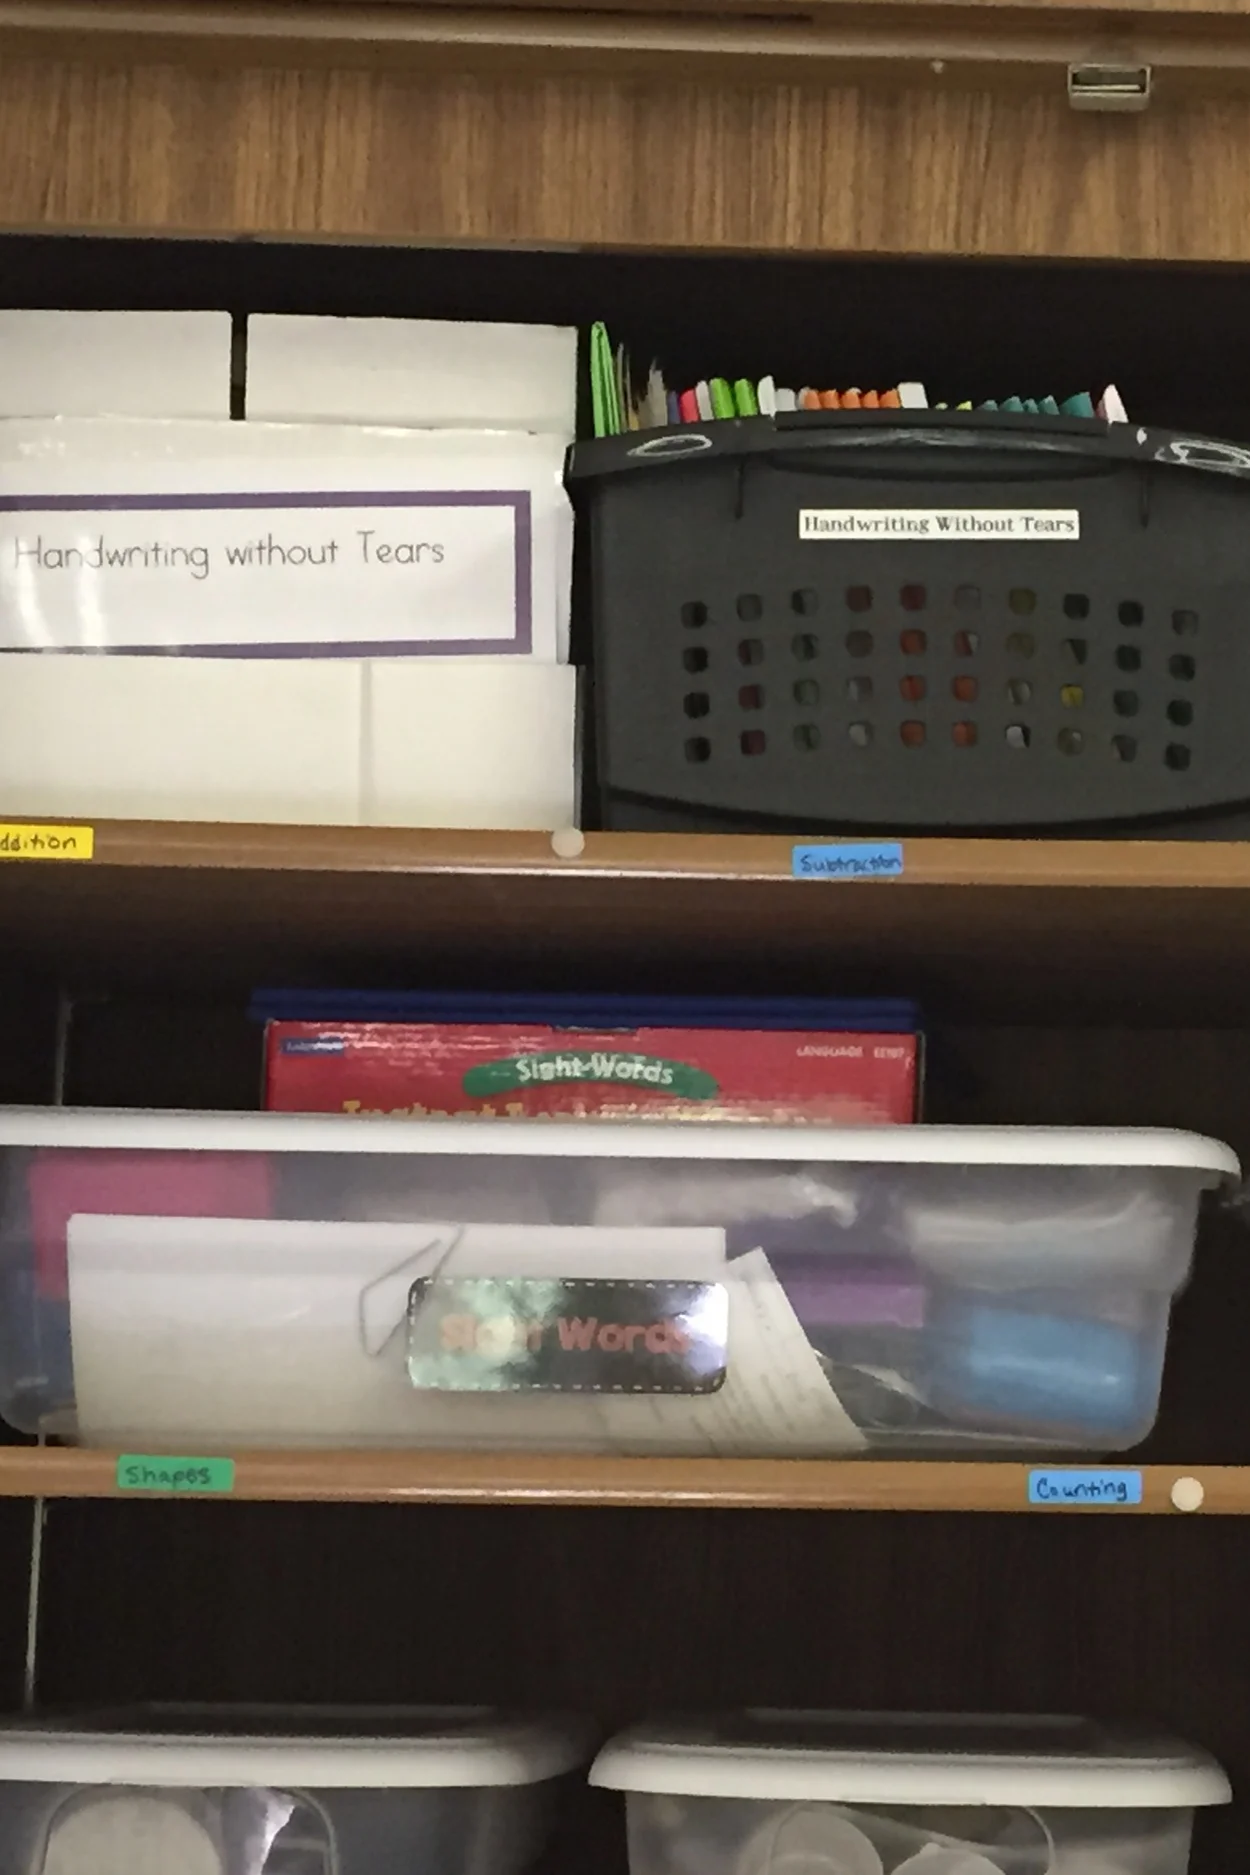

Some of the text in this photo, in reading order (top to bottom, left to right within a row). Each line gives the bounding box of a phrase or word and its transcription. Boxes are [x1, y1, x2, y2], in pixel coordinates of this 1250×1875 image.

[803, 515, 1075, 533] Handwriting Without Tears
[14, 530, 445, 580] Handwriting without Tears
[0, 831, 77, 852] ddition
[125, 1465, 211, 1488] Shapes
[1036, 1477, 1128, 1502] Counting
